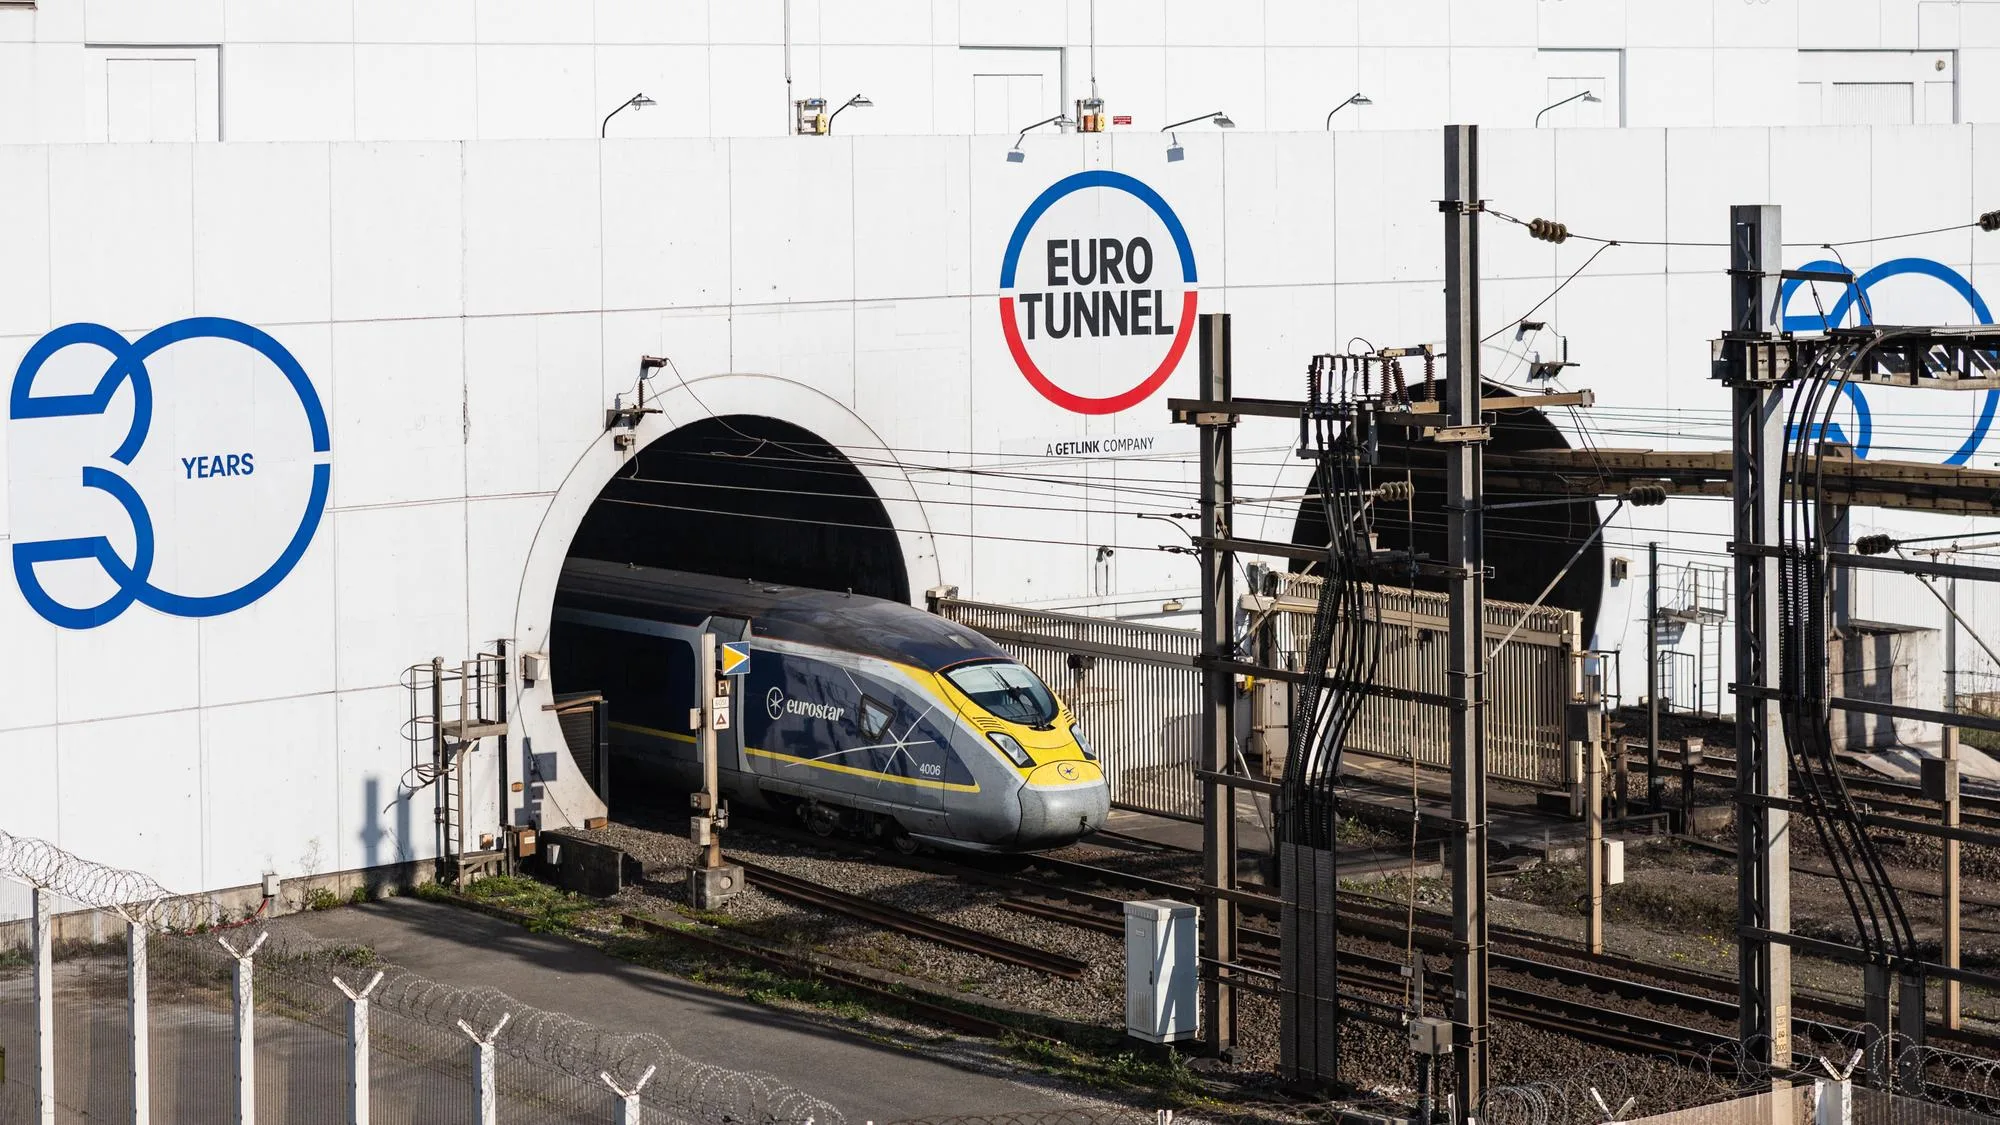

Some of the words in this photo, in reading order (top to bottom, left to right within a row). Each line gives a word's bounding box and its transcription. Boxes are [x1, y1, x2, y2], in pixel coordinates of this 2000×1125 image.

[1047, 236, 1153, 286] EURO
[1019, 290, 1174, 340] TUNNEL
[1046, 443, 1053, 456] A
[1055, 440, 1100, 455] GETLINK
[1103, 437, 1154, 452] COMPANY
[10, 317, 330, 630] 30
[182, 453, 254, 479] YEARS
[786, 698, 844, 722] eurostar
[919, 763, 941, 776] 4006
